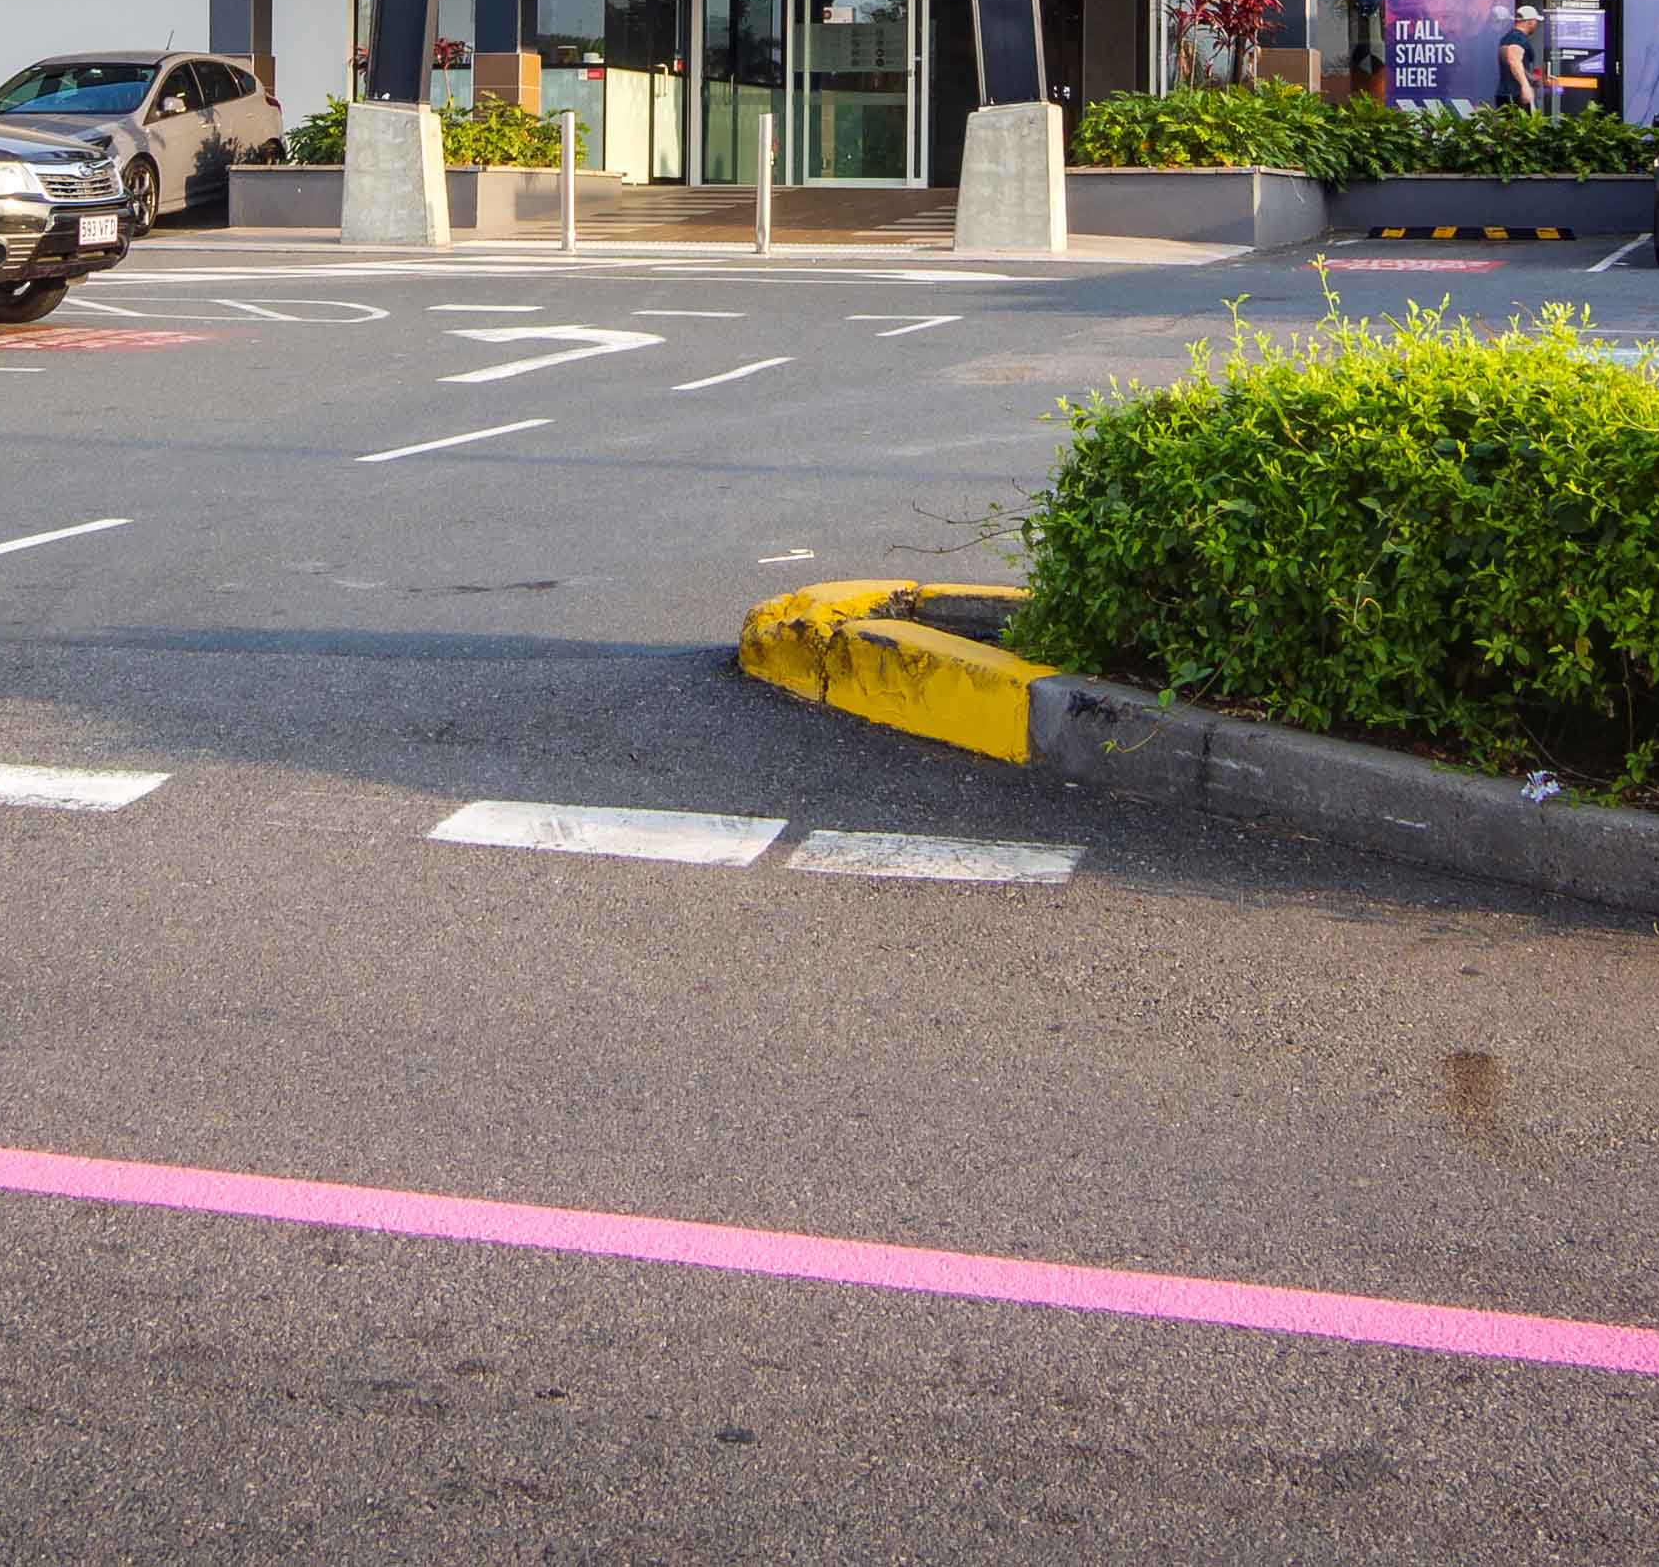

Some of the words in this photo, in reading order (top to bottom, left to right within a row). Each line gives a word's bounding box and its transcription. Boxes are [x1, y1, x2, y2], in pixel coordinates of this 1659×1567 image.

[1395, 19, 1411, 41] IT
[1414, 19, 1445, 41] ALL
[1395, 43, 1456, 65] STARTS
[1395, 67, 1438, 88] HERE
